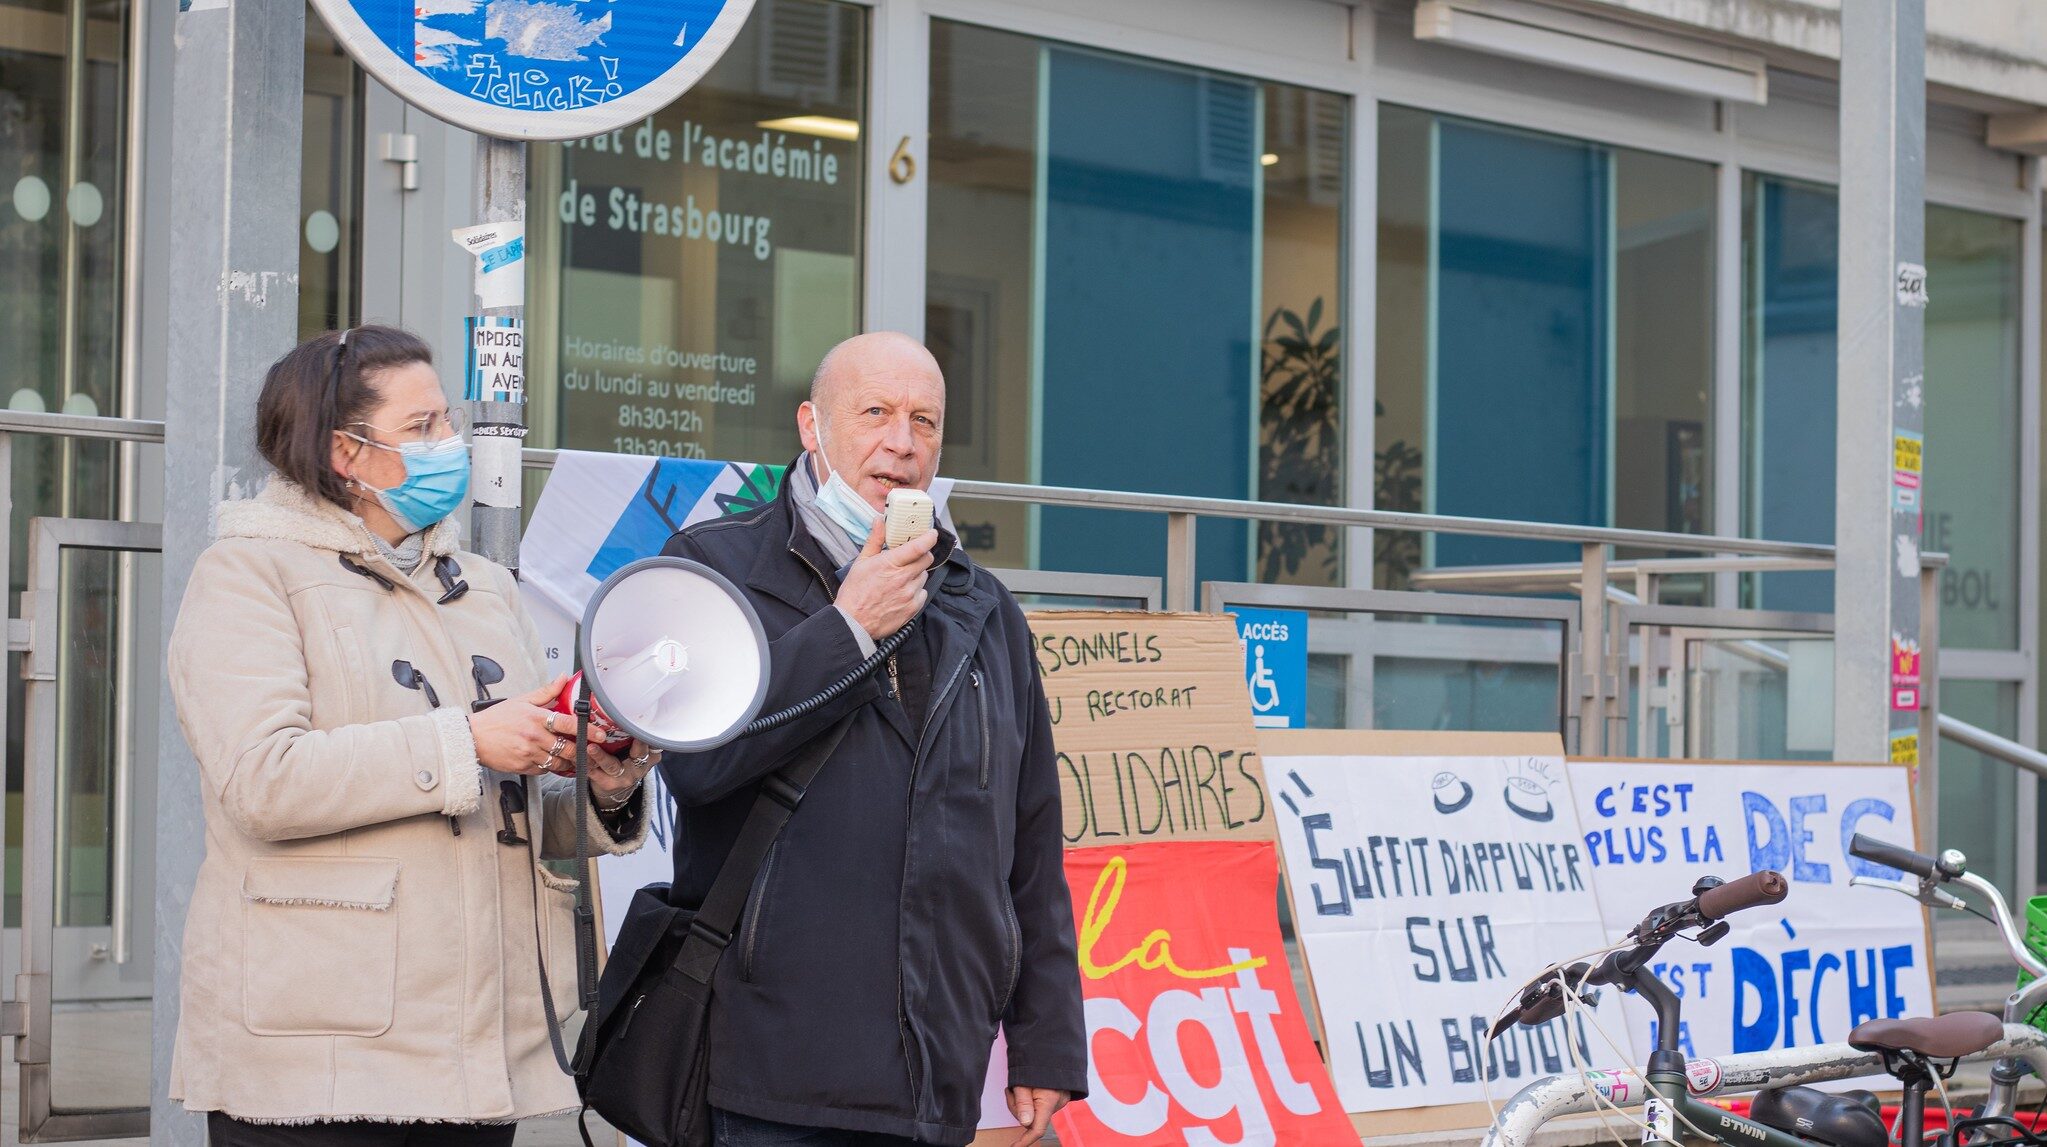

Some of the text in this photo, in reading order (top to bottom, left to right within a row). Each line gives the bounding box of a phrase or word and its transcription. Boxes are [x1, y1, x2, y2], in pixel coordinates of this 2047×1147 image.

[635, 116, 671, 161] de
[684, 120, 838, 187] l'académie
[889, 135, 917, 185] 6
[559, 180, 771, 260] de Strasbourg
[480, 352, 497, 367] UN
[564, 335, 757, 375] Horaires d'ouverture
[564, 368, 756, 406] du lundi au vendredi
[619, 405, 703, 433] 8h30-12h
[614, 437, 706, 460] 13h30-17h
[1242, 620, 1289, 641] ACCÈS
[1031, 632, 1162, 677] RSONNELS
[1046, 686, 1198, 725] U RECTORAT
[1057, 745, 1265, 843] OLIDAIRES
[1595, 782, 1693, 818] C'EST
[1302, 812, 1585, 916] SUFFIT D'APPUYER
[1584, 826, 1724, 867] PLUS LA
[1077, 855, 1268, 980] la
[1406, 914, 1506, 982] SUR
[1082, 947, 1322, 1147] cgt
[1356, 1018, 1427, 1089] UN
